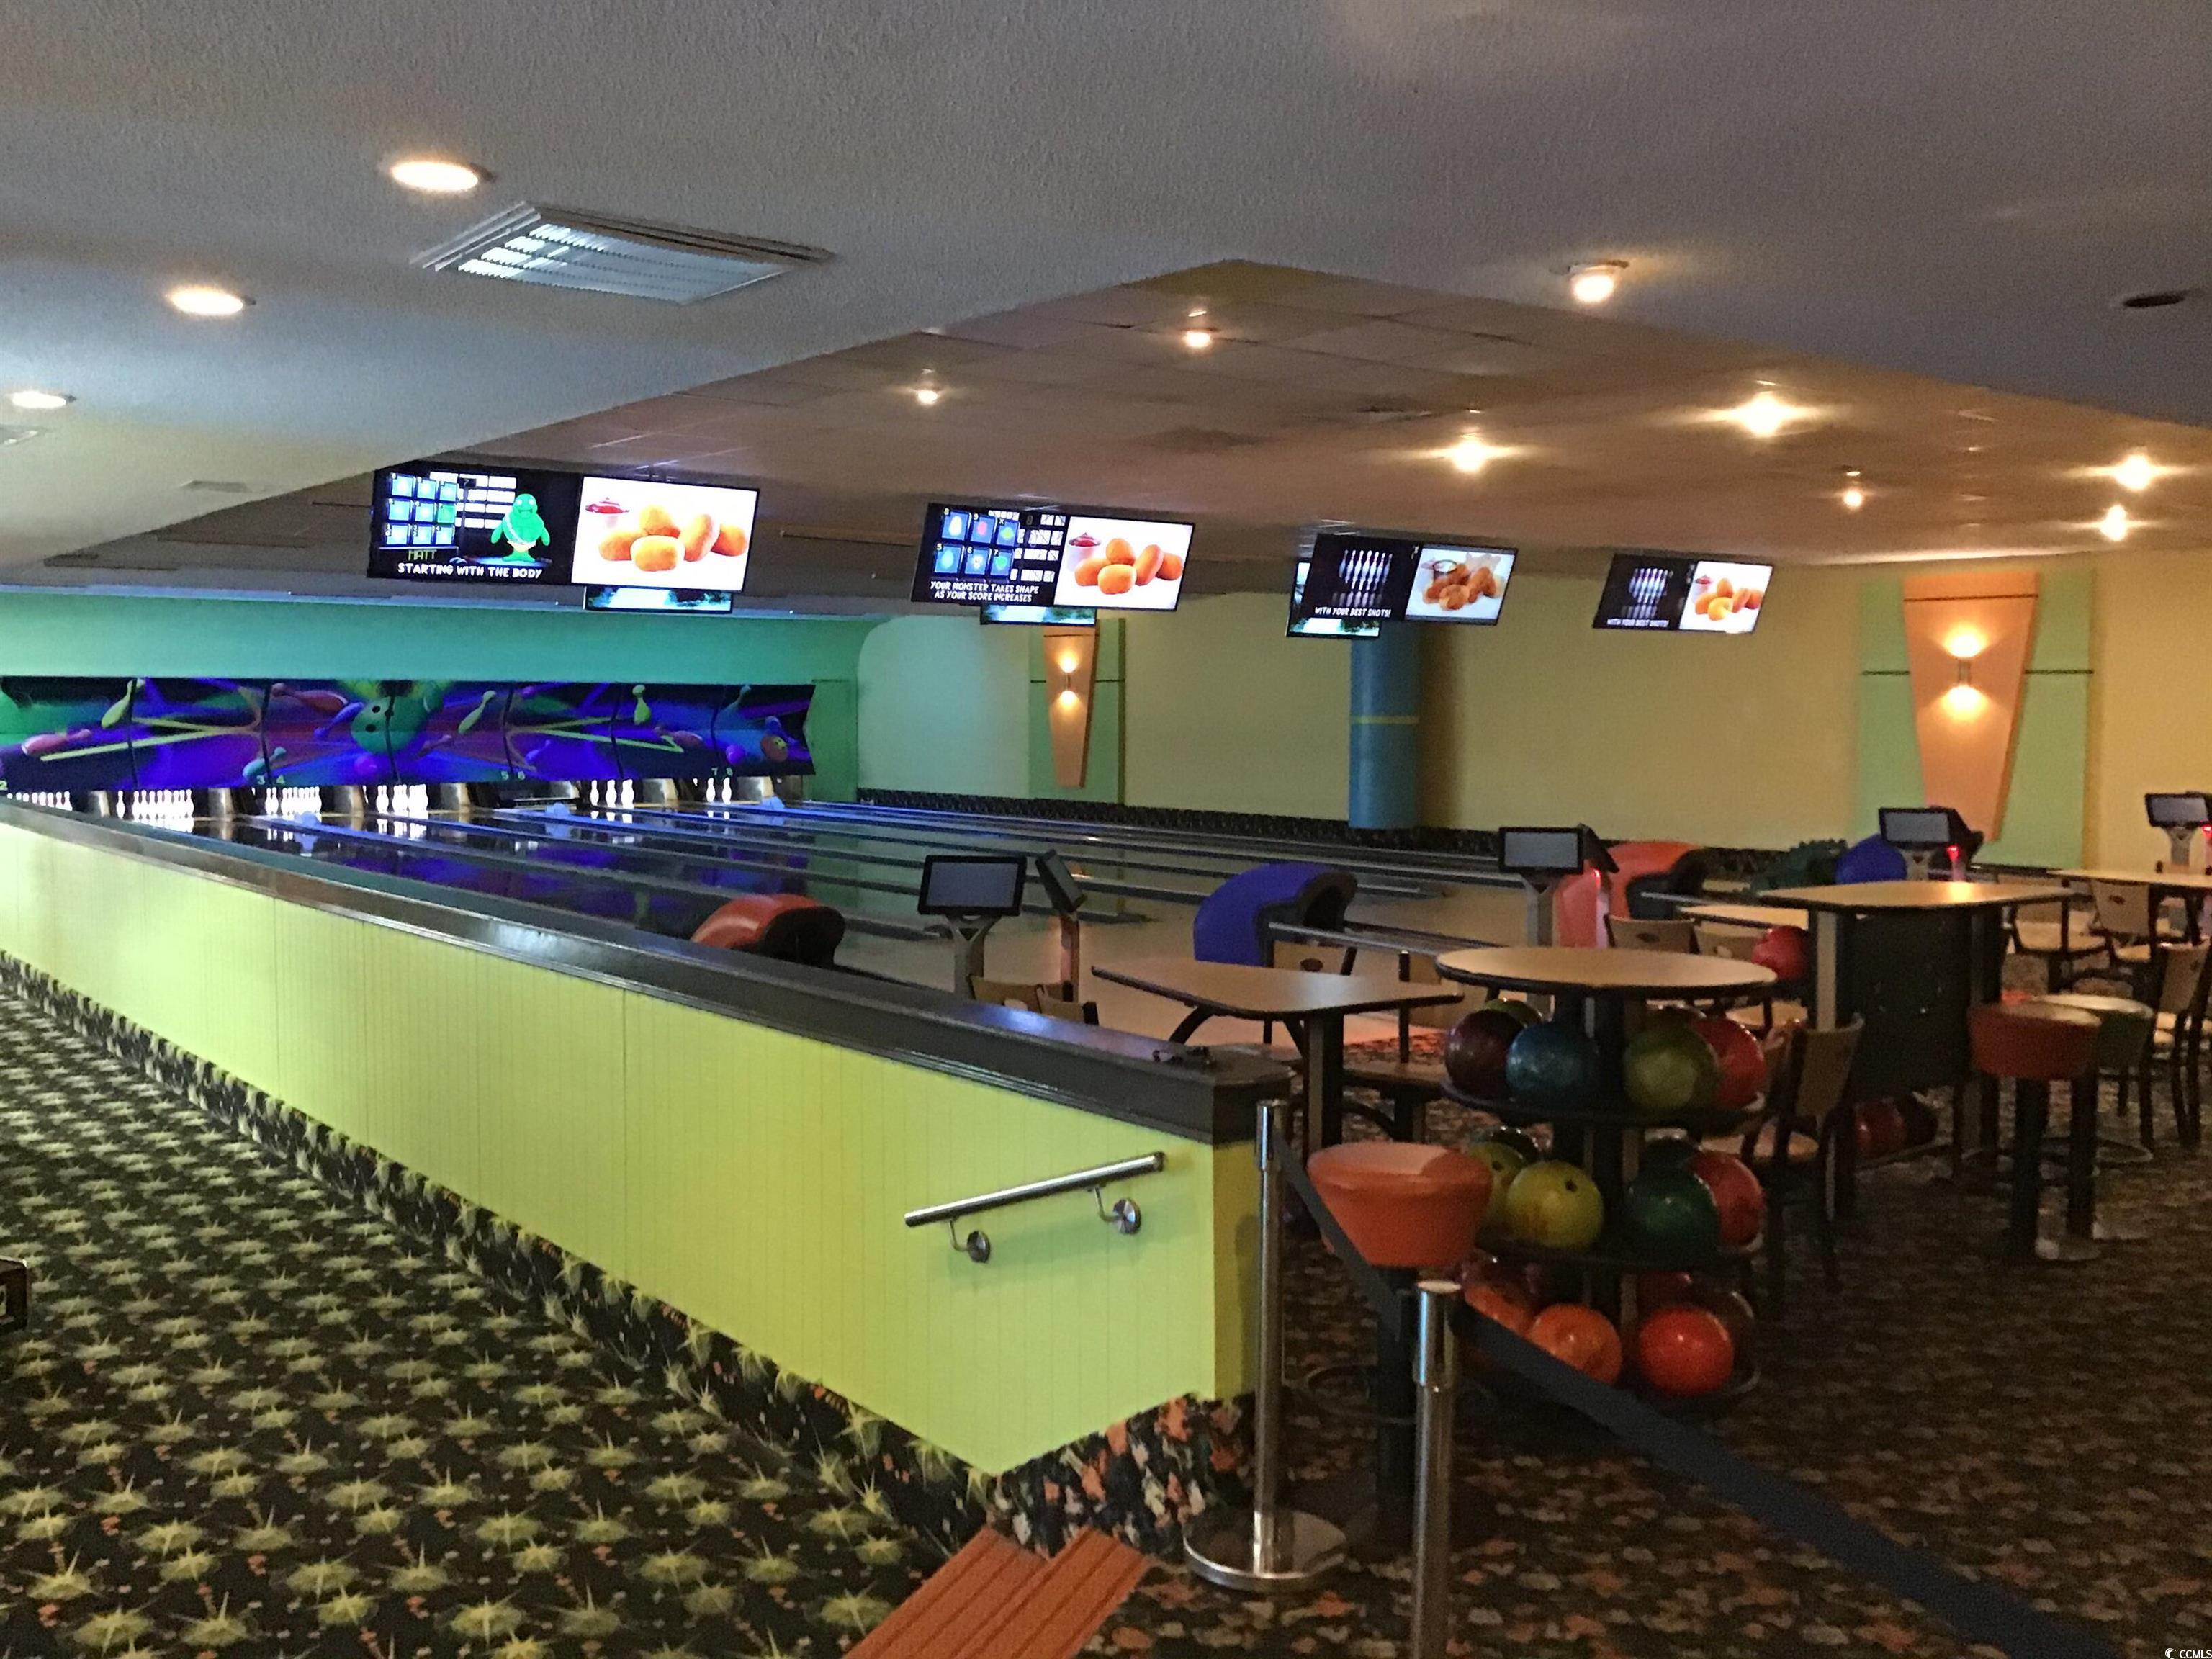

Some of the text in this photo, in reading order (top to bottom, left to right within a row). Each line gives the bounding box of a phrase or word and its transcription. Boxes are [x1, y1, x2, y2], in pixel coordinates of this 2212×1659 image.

[408, 549, 437, 560] MATT
[397, 562, 543, 579] STARTING WITH THE BODY
[930, 580, 1039, 594] YOUR MONSTER TAKES SHAPE
[934, 590, 1033, 603] AS YOUR SCORE INCREASES
[1315, 606, 1332, 615] WITH
[1332, 607, 1350, 616] YOUR
[1349, 608, 1367, 616] BEST
